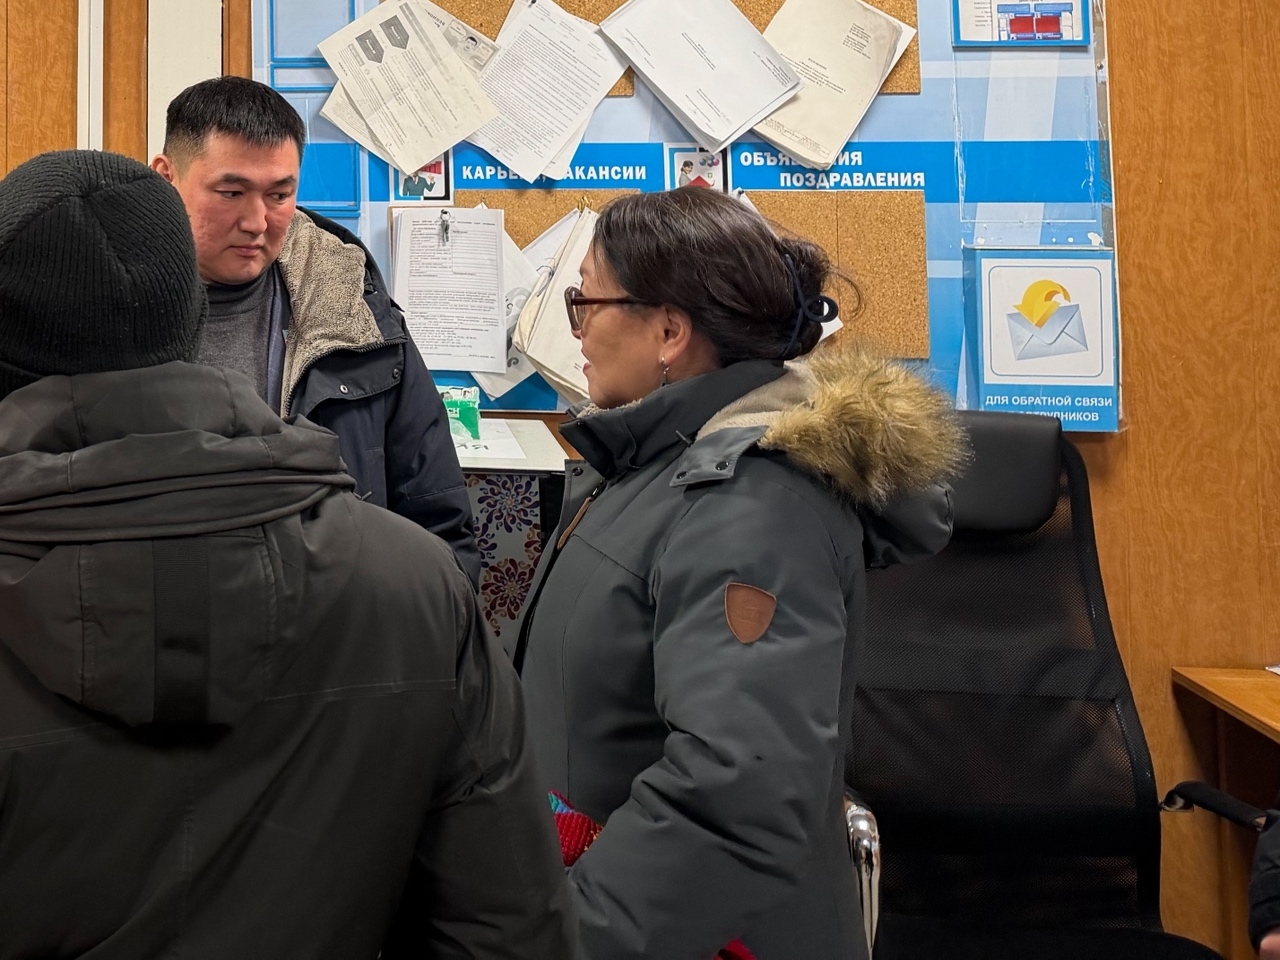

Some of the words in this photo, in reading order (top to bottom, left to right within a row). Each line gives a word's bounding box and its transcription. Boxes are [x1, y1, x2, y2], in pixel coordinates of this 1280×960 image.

[740, 151, 863, 167] ОБЪЯИЯ
[565, 165, 647, 181] АКАНСИИ
[780, 172, 925, 189] ПОЗДРАВЛЕНИЯ
[985, 395, 1009, 406] ДЛЯ
[1012, 395, 1072, 406] ОБРАТНОЙ
[1074, 397, 1113, 407] СВЯЗИ
